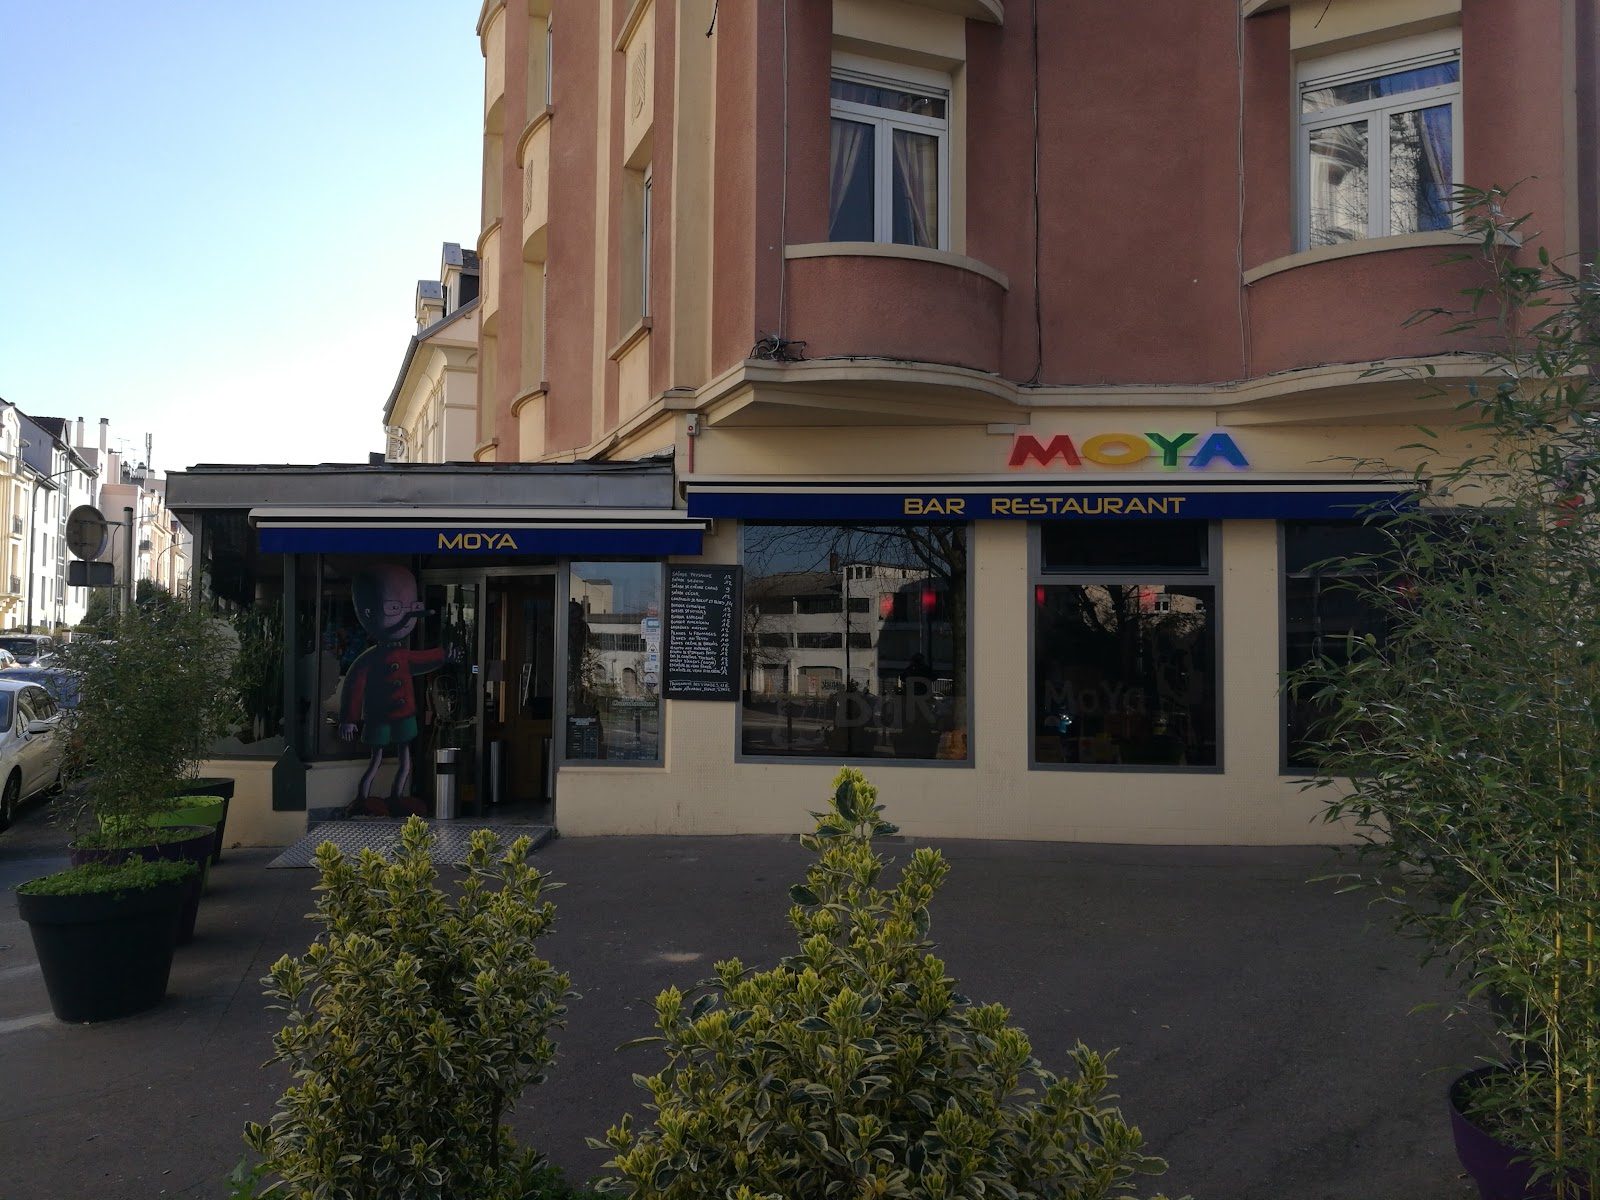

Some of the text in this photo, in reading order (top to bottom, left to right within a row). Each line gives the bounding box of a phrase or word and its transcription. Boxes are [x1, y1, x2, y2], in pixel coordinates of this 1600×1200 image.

[1008, 432, 1250, 466] MOYA
[904, 497, 1187, 515] BAR RESTAURANT
[438, 533, 518, 550] MOYA
